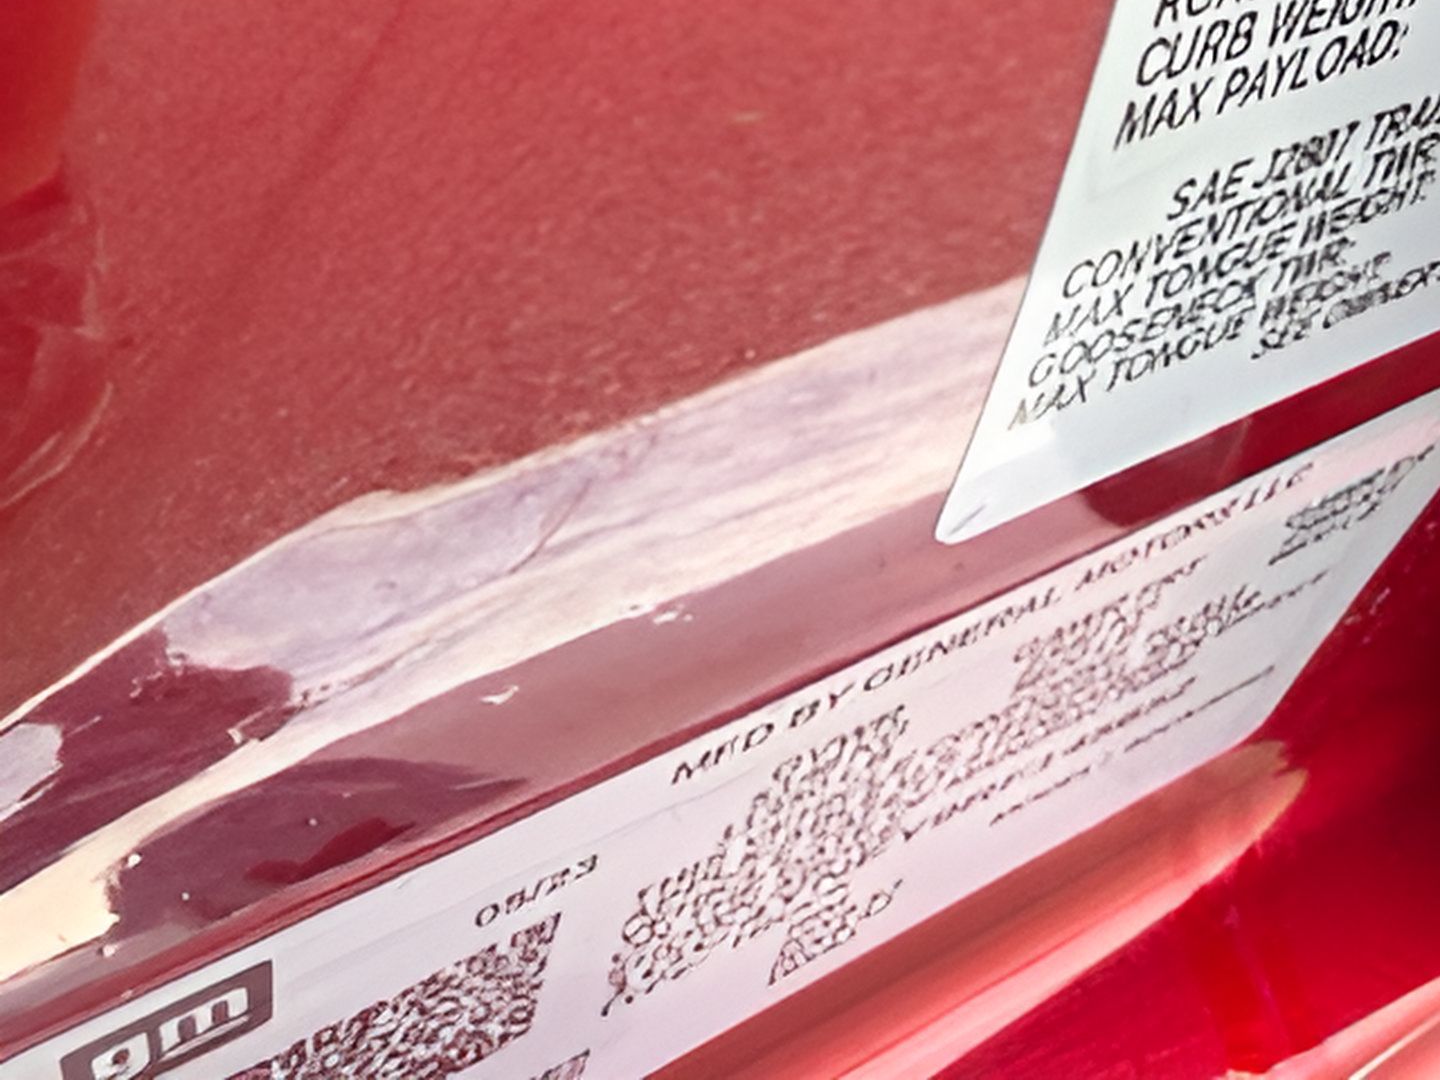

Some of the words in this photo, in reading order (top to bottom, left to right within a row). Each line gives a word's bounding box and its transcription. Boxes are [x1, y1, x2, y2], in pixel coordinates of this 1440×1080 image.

[1114, 76, 1215, 152] MAX
[1217, 20, 1409, 115] PAYLOAD:
[1136, 11, 1258, 87] CURB
[1062, 161, 1353, 299] CONVENTIONAL
[1167, 159, 1254, 221] SAE
[1044, 283, 1134, 347] MAX
[1145, 221, 1297, 308] TONGUE
[789, 682, 856, 728] BY
